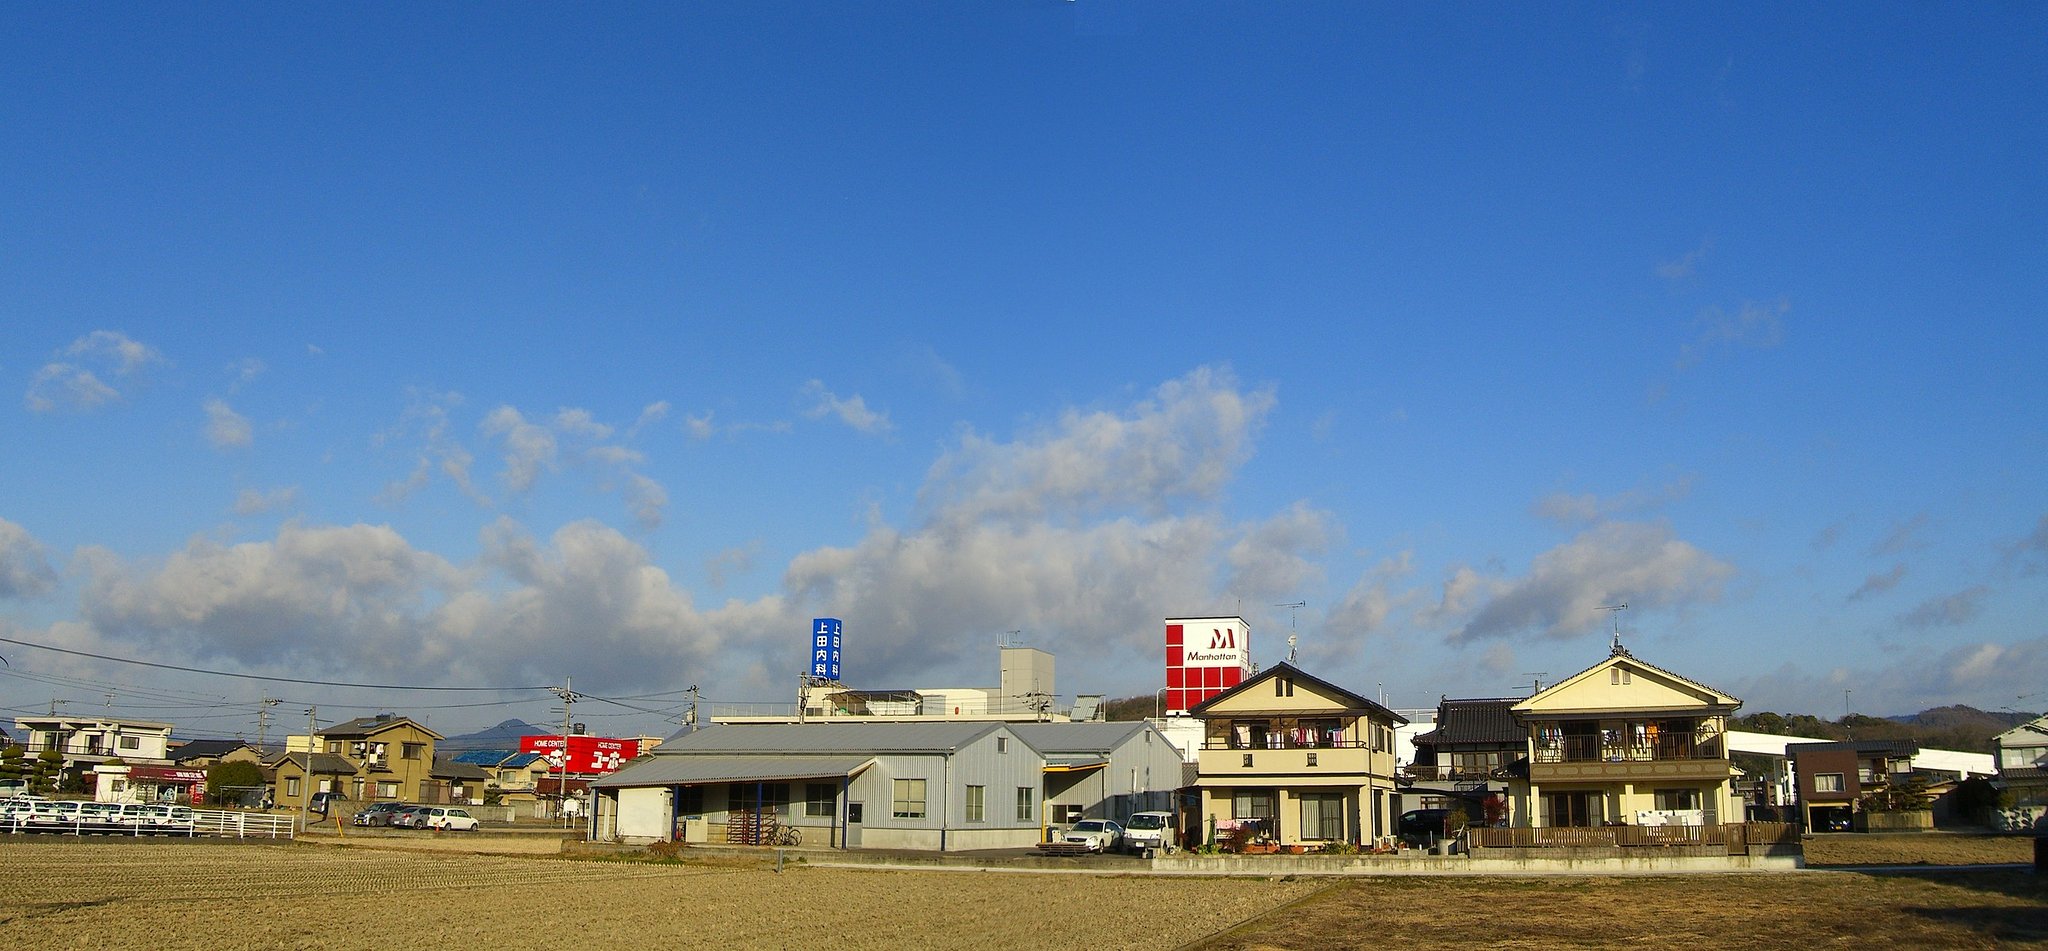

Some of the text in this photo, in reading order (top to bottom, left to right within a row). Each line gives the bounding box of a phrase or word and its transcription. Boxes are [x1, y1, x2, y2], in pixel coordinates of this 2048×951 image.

[816, 621, 828, 676] 上田内科
[832, 622, 840, 677] 上田内科
[1187, 651, 1237, 661] Manhattan
[534, 740, 565, 748] HOME CENTE
[591, 751, 627, 769] ユーホー
